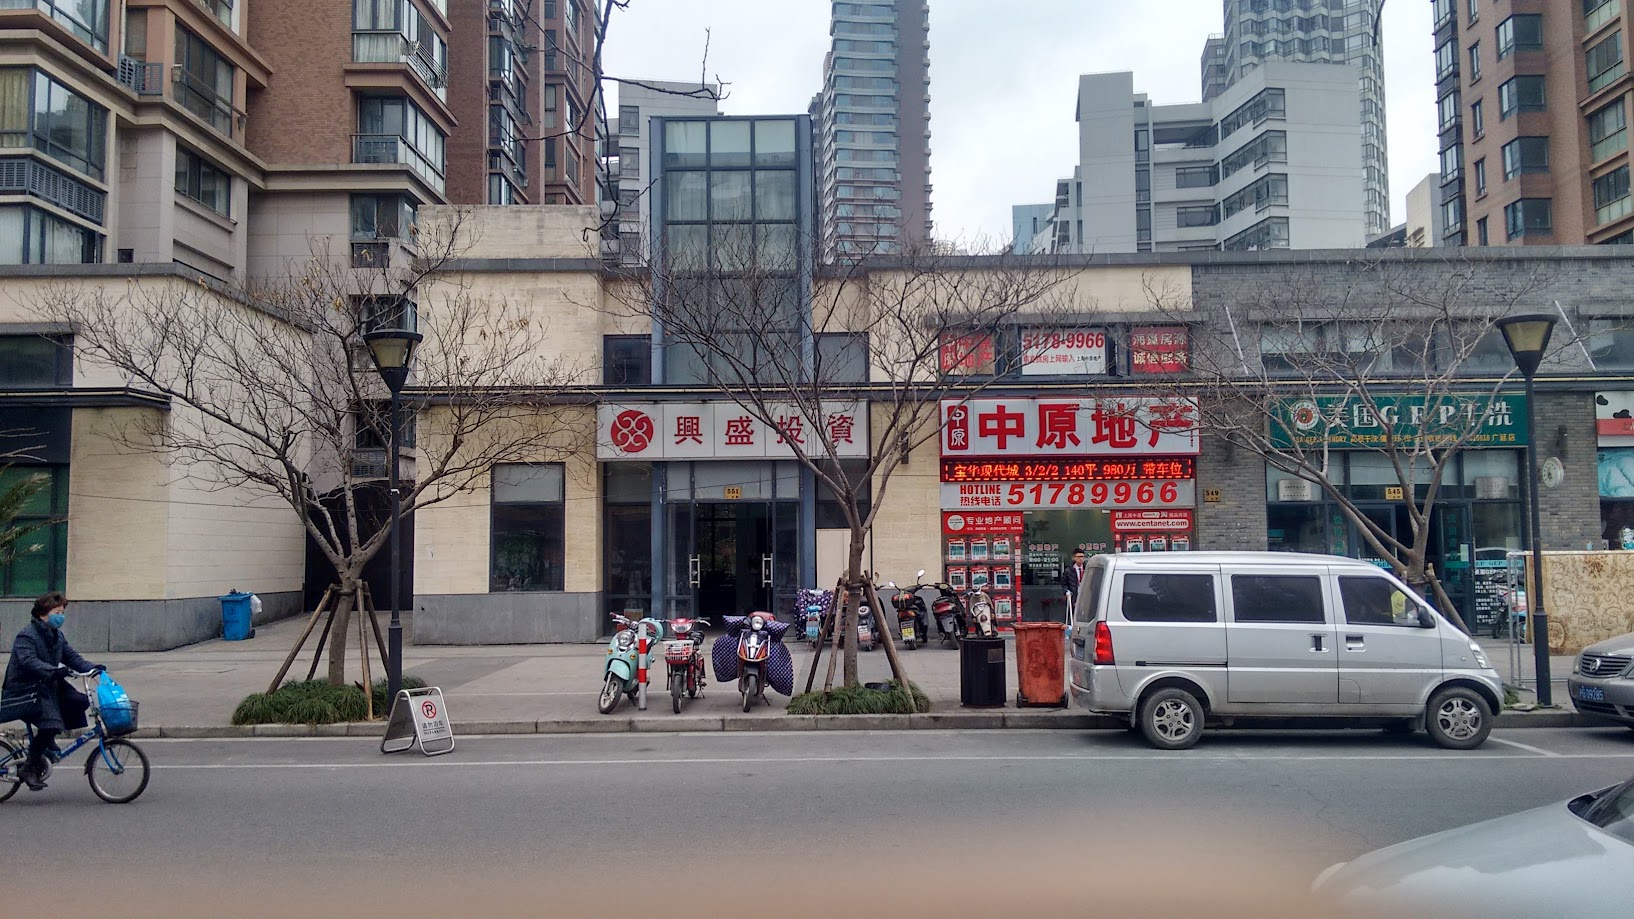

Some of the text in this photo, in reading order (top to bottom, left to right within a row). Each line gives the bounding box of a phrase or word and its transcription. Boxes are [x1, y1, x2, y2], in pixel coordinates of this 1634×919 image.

[1023, 332, 1105, 349] 5178-9966
[674, 414, 854, 445] 興盛投資
[951, 408, 966, 447] 中原
[978, 403, 1193, 449] 中原地产
[954, 464, 1020, 478] 宝华现代城
[1025, 464, 1059, 477] 3/2/2
[1065, 463, 1098, 477] 140平
[1143, 461, 1183, 476] 带车位
[960, 484, 1001, 495] HOTLINE
[1006, 481, 1178, 505] 51789966
[960, 496, 1001, 507] 热线电话
[966, 515, 1021, 525] 专业地产顾问
